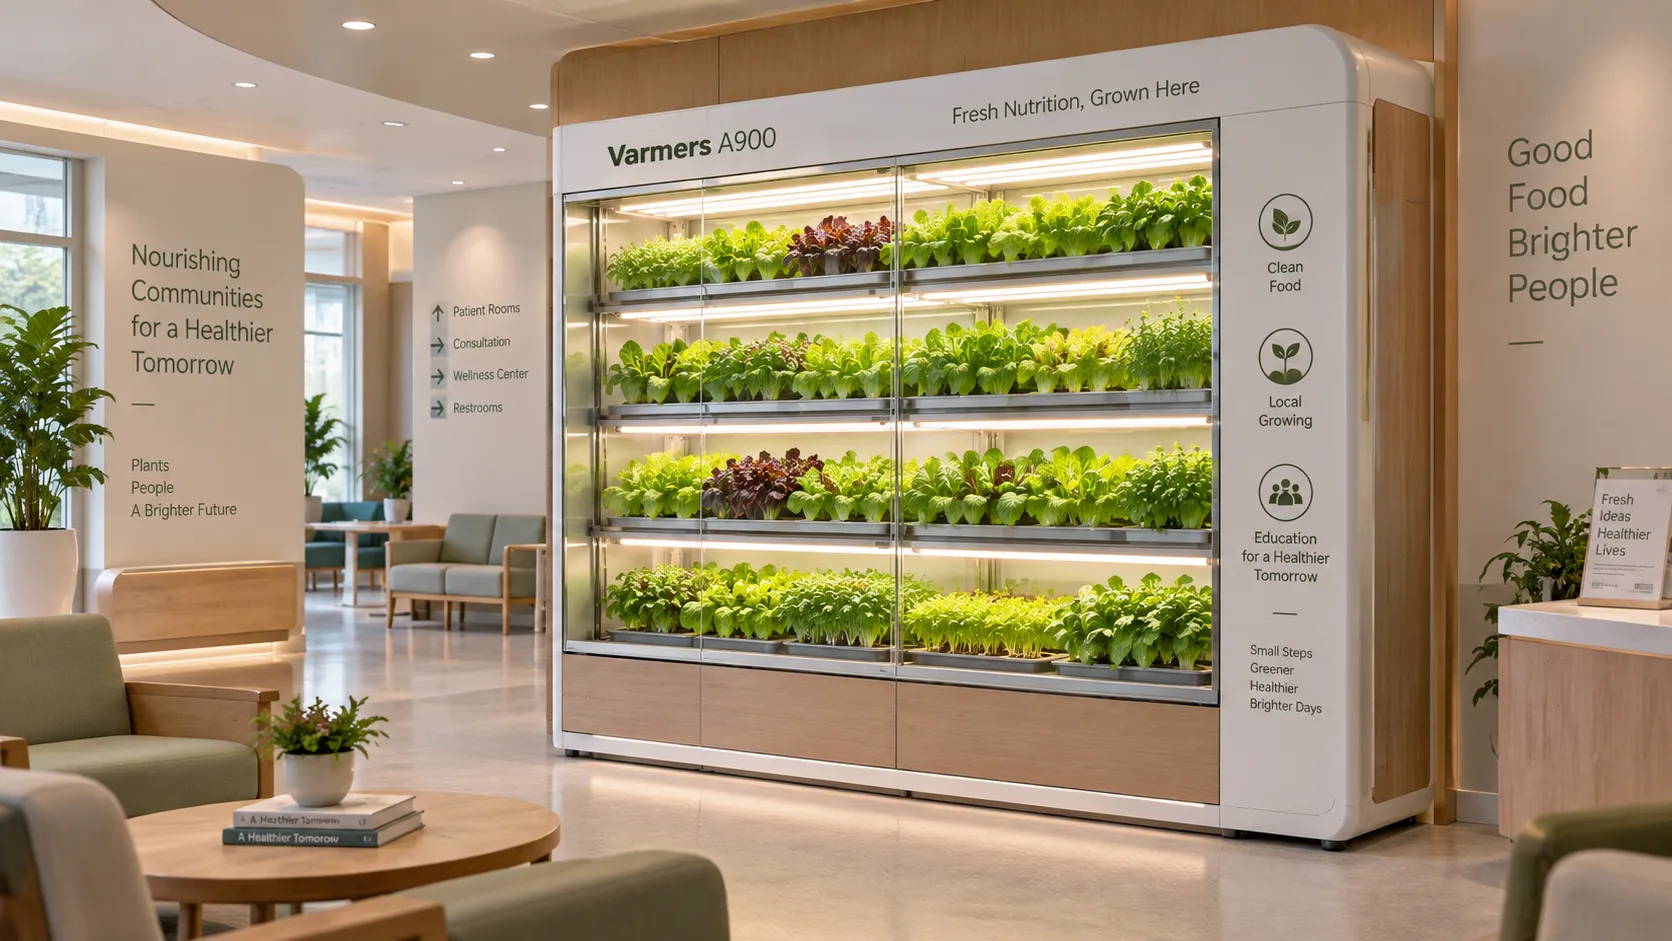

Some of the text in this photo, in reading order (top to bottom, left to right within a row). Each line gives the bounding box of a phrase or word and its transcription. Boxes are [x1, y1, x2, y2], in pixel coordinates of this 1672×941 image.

[953, 80, 1199, 124] Fresh Nutrition, Grown Here
[608, 127, 776, 166] Varmers A900
[1508, 130, 1592, 167] Good
[1509, 176, 1587, 212] Food
[1509, 222, 1637, 261] Brighter
[132, 244, 240, 279] Nourishing
[1267, 261, 1304, 274] Clean
[1269, 278, 1302, 293] Food
[1509, 267, 1617, 307] People
[131, 279, 264, 309] Communities
[453, 303, 521, 318] Patient Rooms
[132, 314, 273, 342] for a Healthier
[452, 335, 511, 350] Consultation
[131, 351, 234, 375] Tomorrow
[452, 367, 530, 382] Wellness Center
[453, 402, 504, 414] Restrooms
[1269, 394, 1302, 409] Local
[1258, 413, 1313, 430] Growing
[131, 457, 170, 472] Plants
[131, 480, 175, 497] People
[1601, 493, 1634, 506] Fresh
[130, 502, 237, 520] A Brighter Future
[1599, 510, 1632, 522] Ideas
[1254, 530, 1317, 545] Education
[1597, 526, 1652, 541] Healthier
[1241, 549, 1330, 565] for a Healthier
[1595, 543, 1626, 557] Lives
[1253, 568, 1319, 583] Tomorrow
[1250, 644, 1313, 661] Small Steps
[1250, 661, 1295, 676] Greener
[1250, 679, 1299, 694] Healthier
[1250, 697, 1323, 716] Brighter Days
[237, 831, 246, 842] A
[247, 832, 292, 843] Healthier
